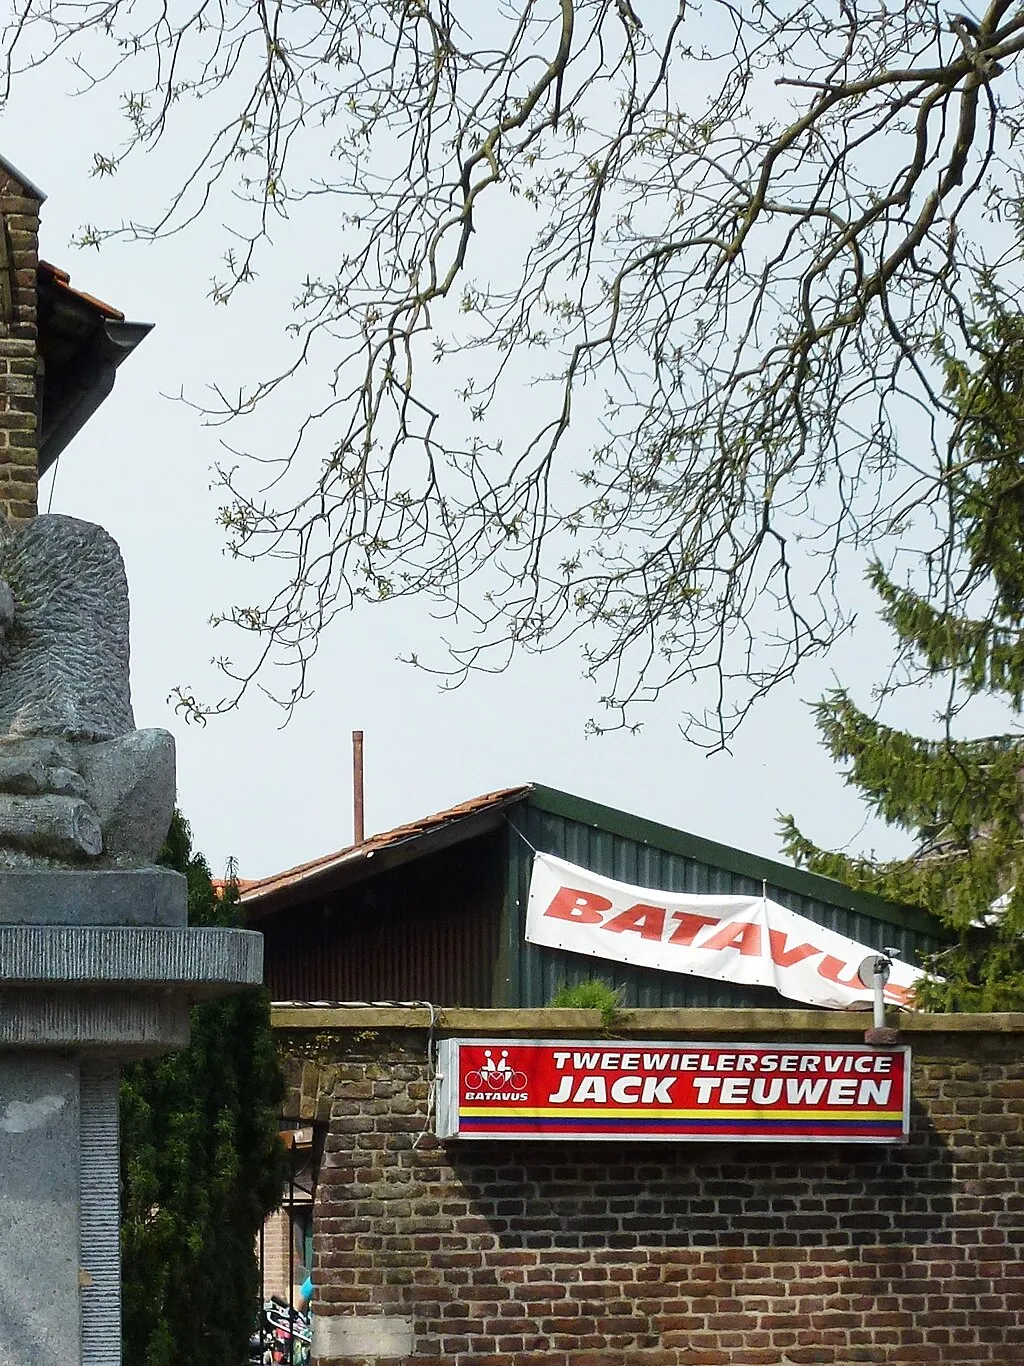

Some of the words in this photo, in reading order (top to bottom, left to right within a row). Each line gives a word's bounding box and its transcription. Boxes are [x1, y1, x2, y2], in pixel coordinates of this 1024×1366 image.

[553, 1052, 892, 1073] TWEEWIELERSERVICE
[465, 1092, 528, 1101] BATAVUS
[548, 1075, 676, 1104] JACK
[693, 1077, 892, 1105] TEUWEN
